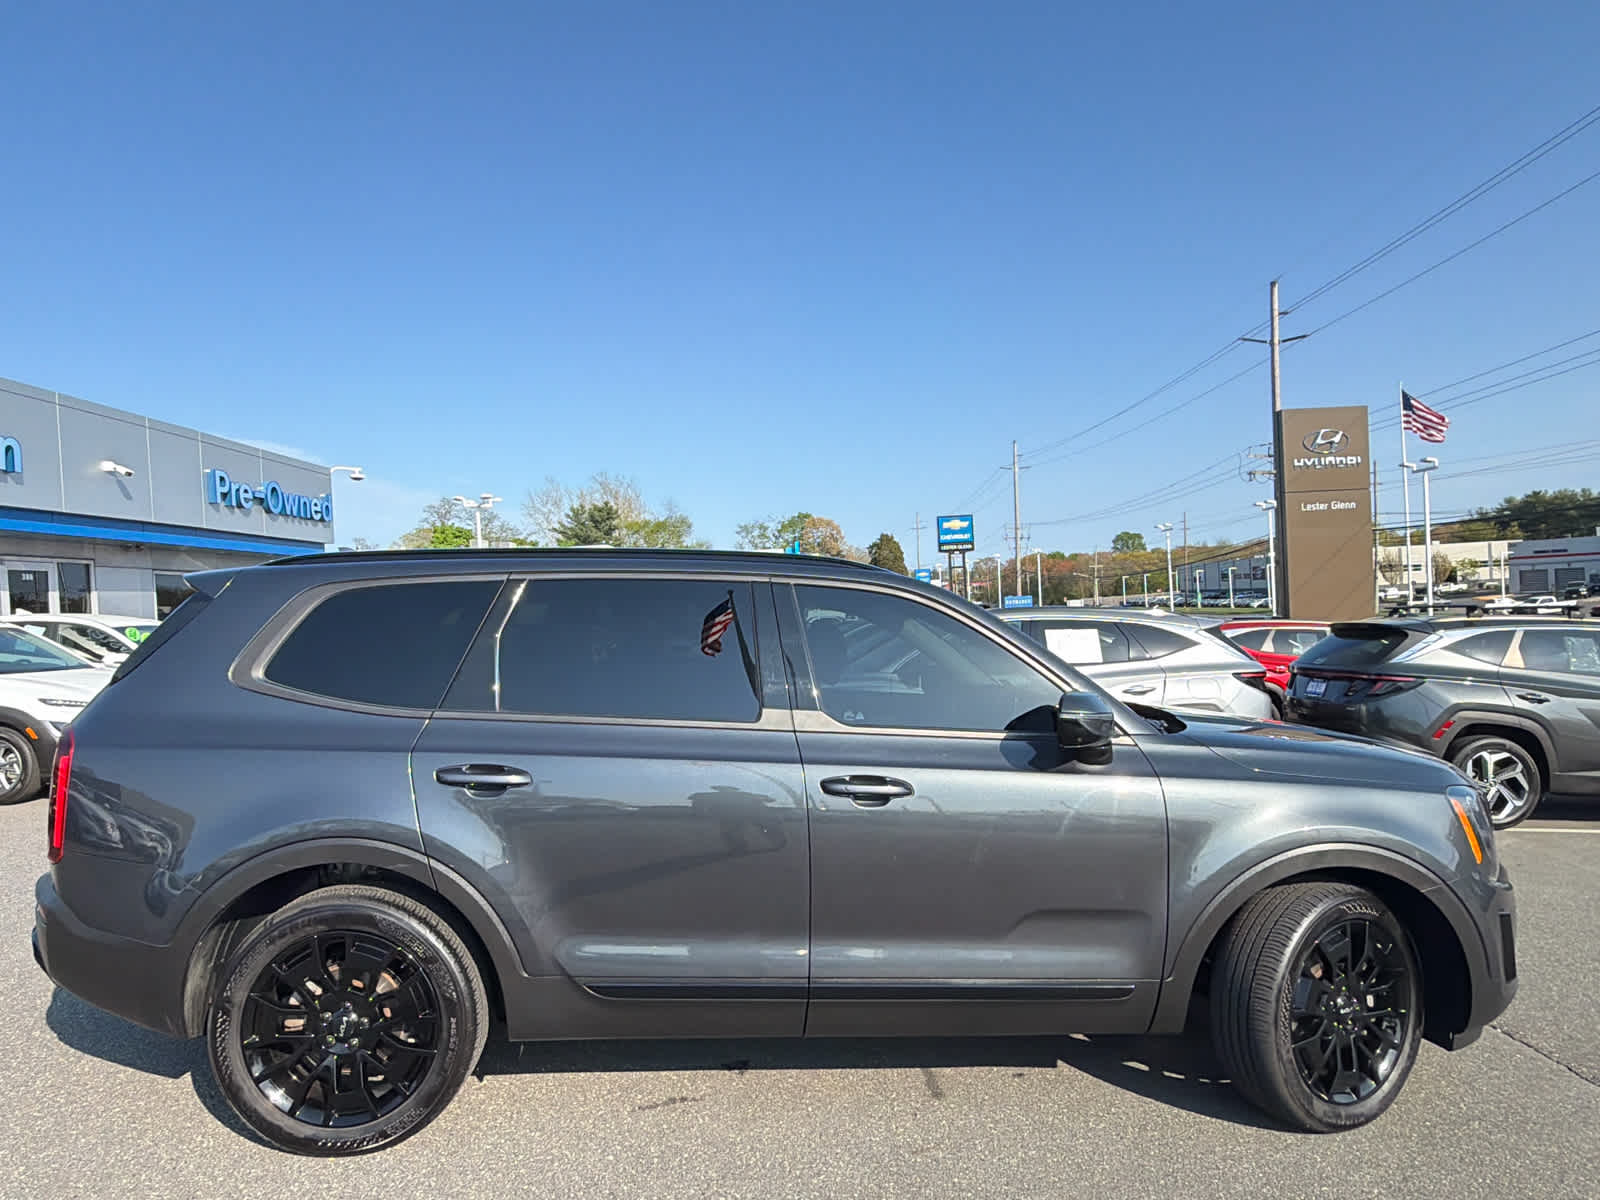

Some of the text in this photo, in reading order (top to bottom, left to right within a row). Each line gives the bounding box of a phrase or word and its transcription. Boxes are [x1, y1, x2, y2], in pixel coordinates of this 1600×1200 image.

[1293, 456, 1361, 468] HYUNDAI
[208, 469, 331, 522] Pre-Owned
[1301, 501, 1356, 511] Lester Glenn
